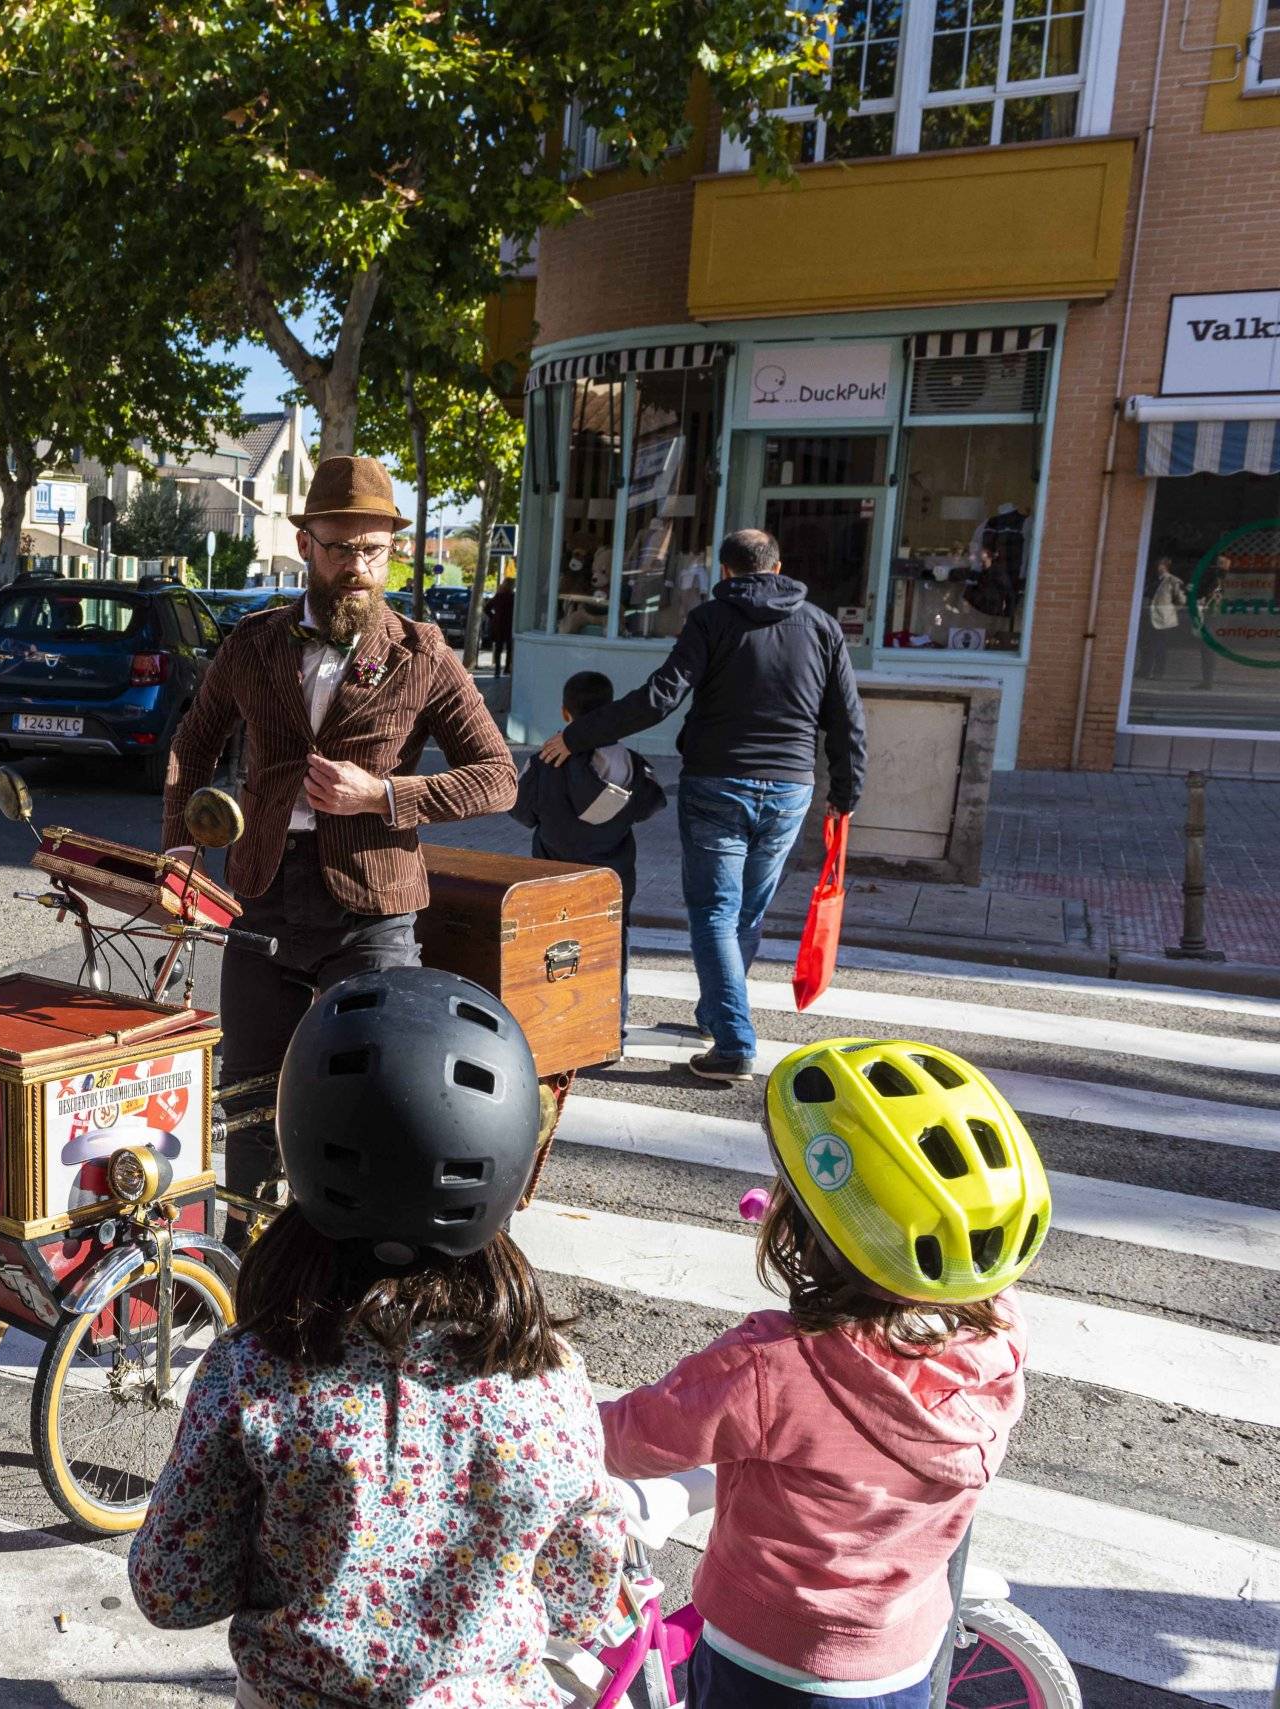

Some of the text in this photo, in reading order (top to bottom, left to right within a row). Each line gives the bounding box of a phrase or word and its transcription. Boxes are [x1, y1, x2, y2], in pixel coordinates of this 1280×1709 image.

[1187, 317, 1280, 341] Valk
[23, 716, 80, 732] 1243 KLC
[58, 1091, 98, 1115] DESCUENTOS
[106, 1079, 149, 1104] PROMOCIONES
[150, 1070, 192, 1092] IRREPETIBLES
